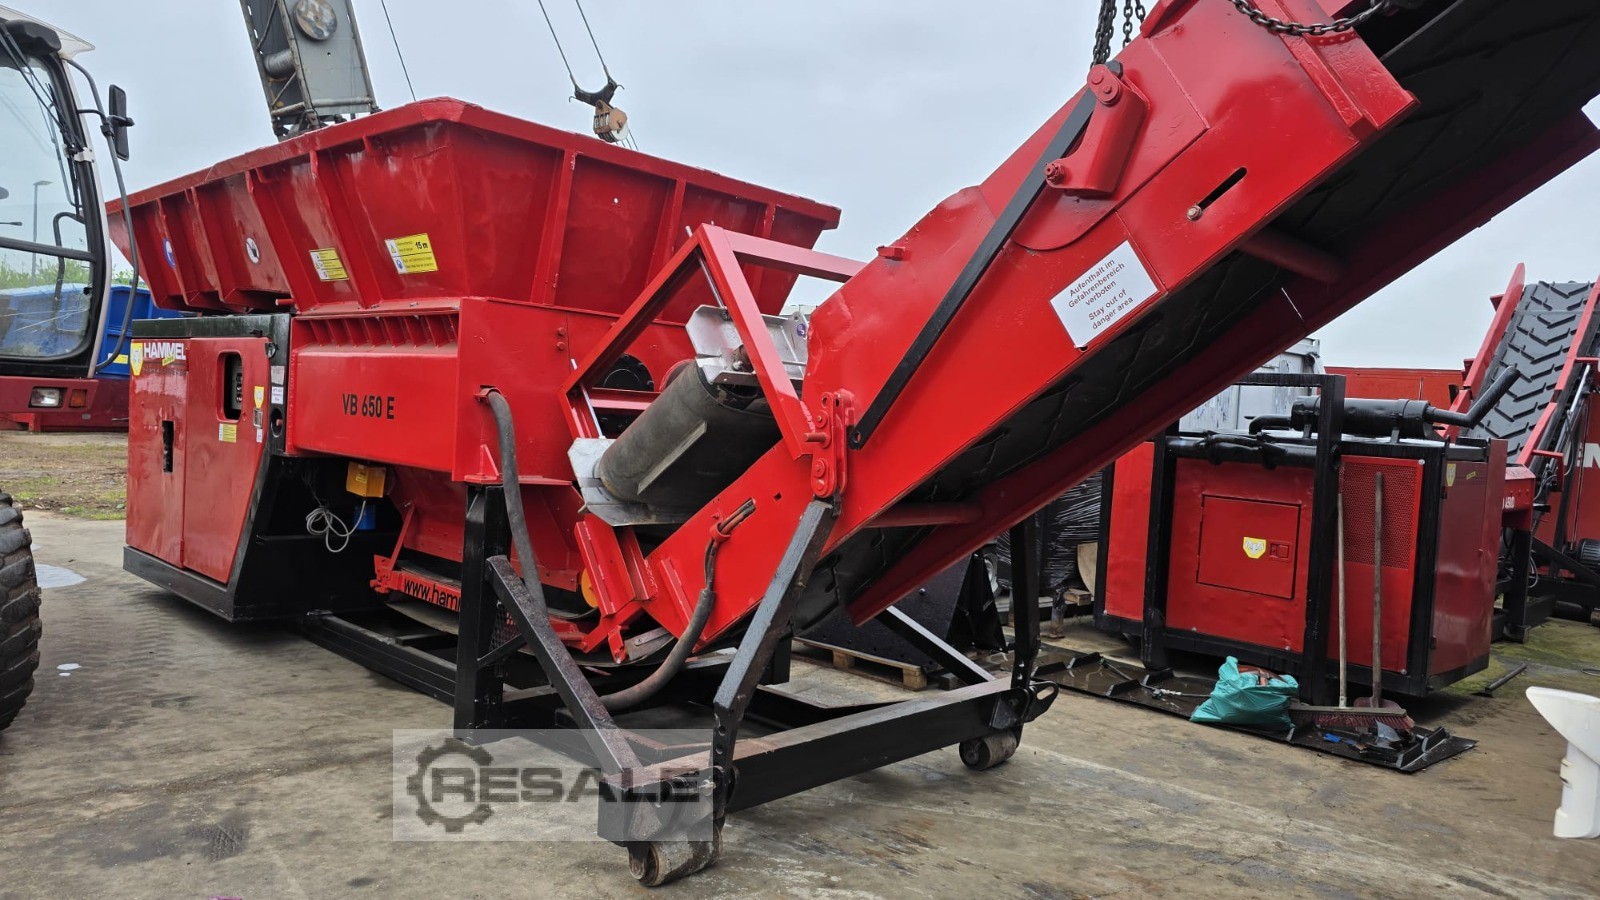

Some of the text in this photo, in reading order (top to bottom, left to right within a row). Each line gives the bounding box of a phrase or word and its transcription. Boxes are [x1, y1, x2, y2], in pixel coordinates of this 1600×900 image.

[415, 241, 423, 250] 15
[1068, 263, 1125, 308] Gefahrenbereich
[1069, 259, 1115, 297] Aufenthalt im
[1085, 280, 1117, 306] verboten
[1088, 288, 1127, 321] Stay out of
[1092, 296, 1134, 330] danger area
[143, 342, 187, 361] HAMMEL
[342, 393, 395, 420] VB 650 E
